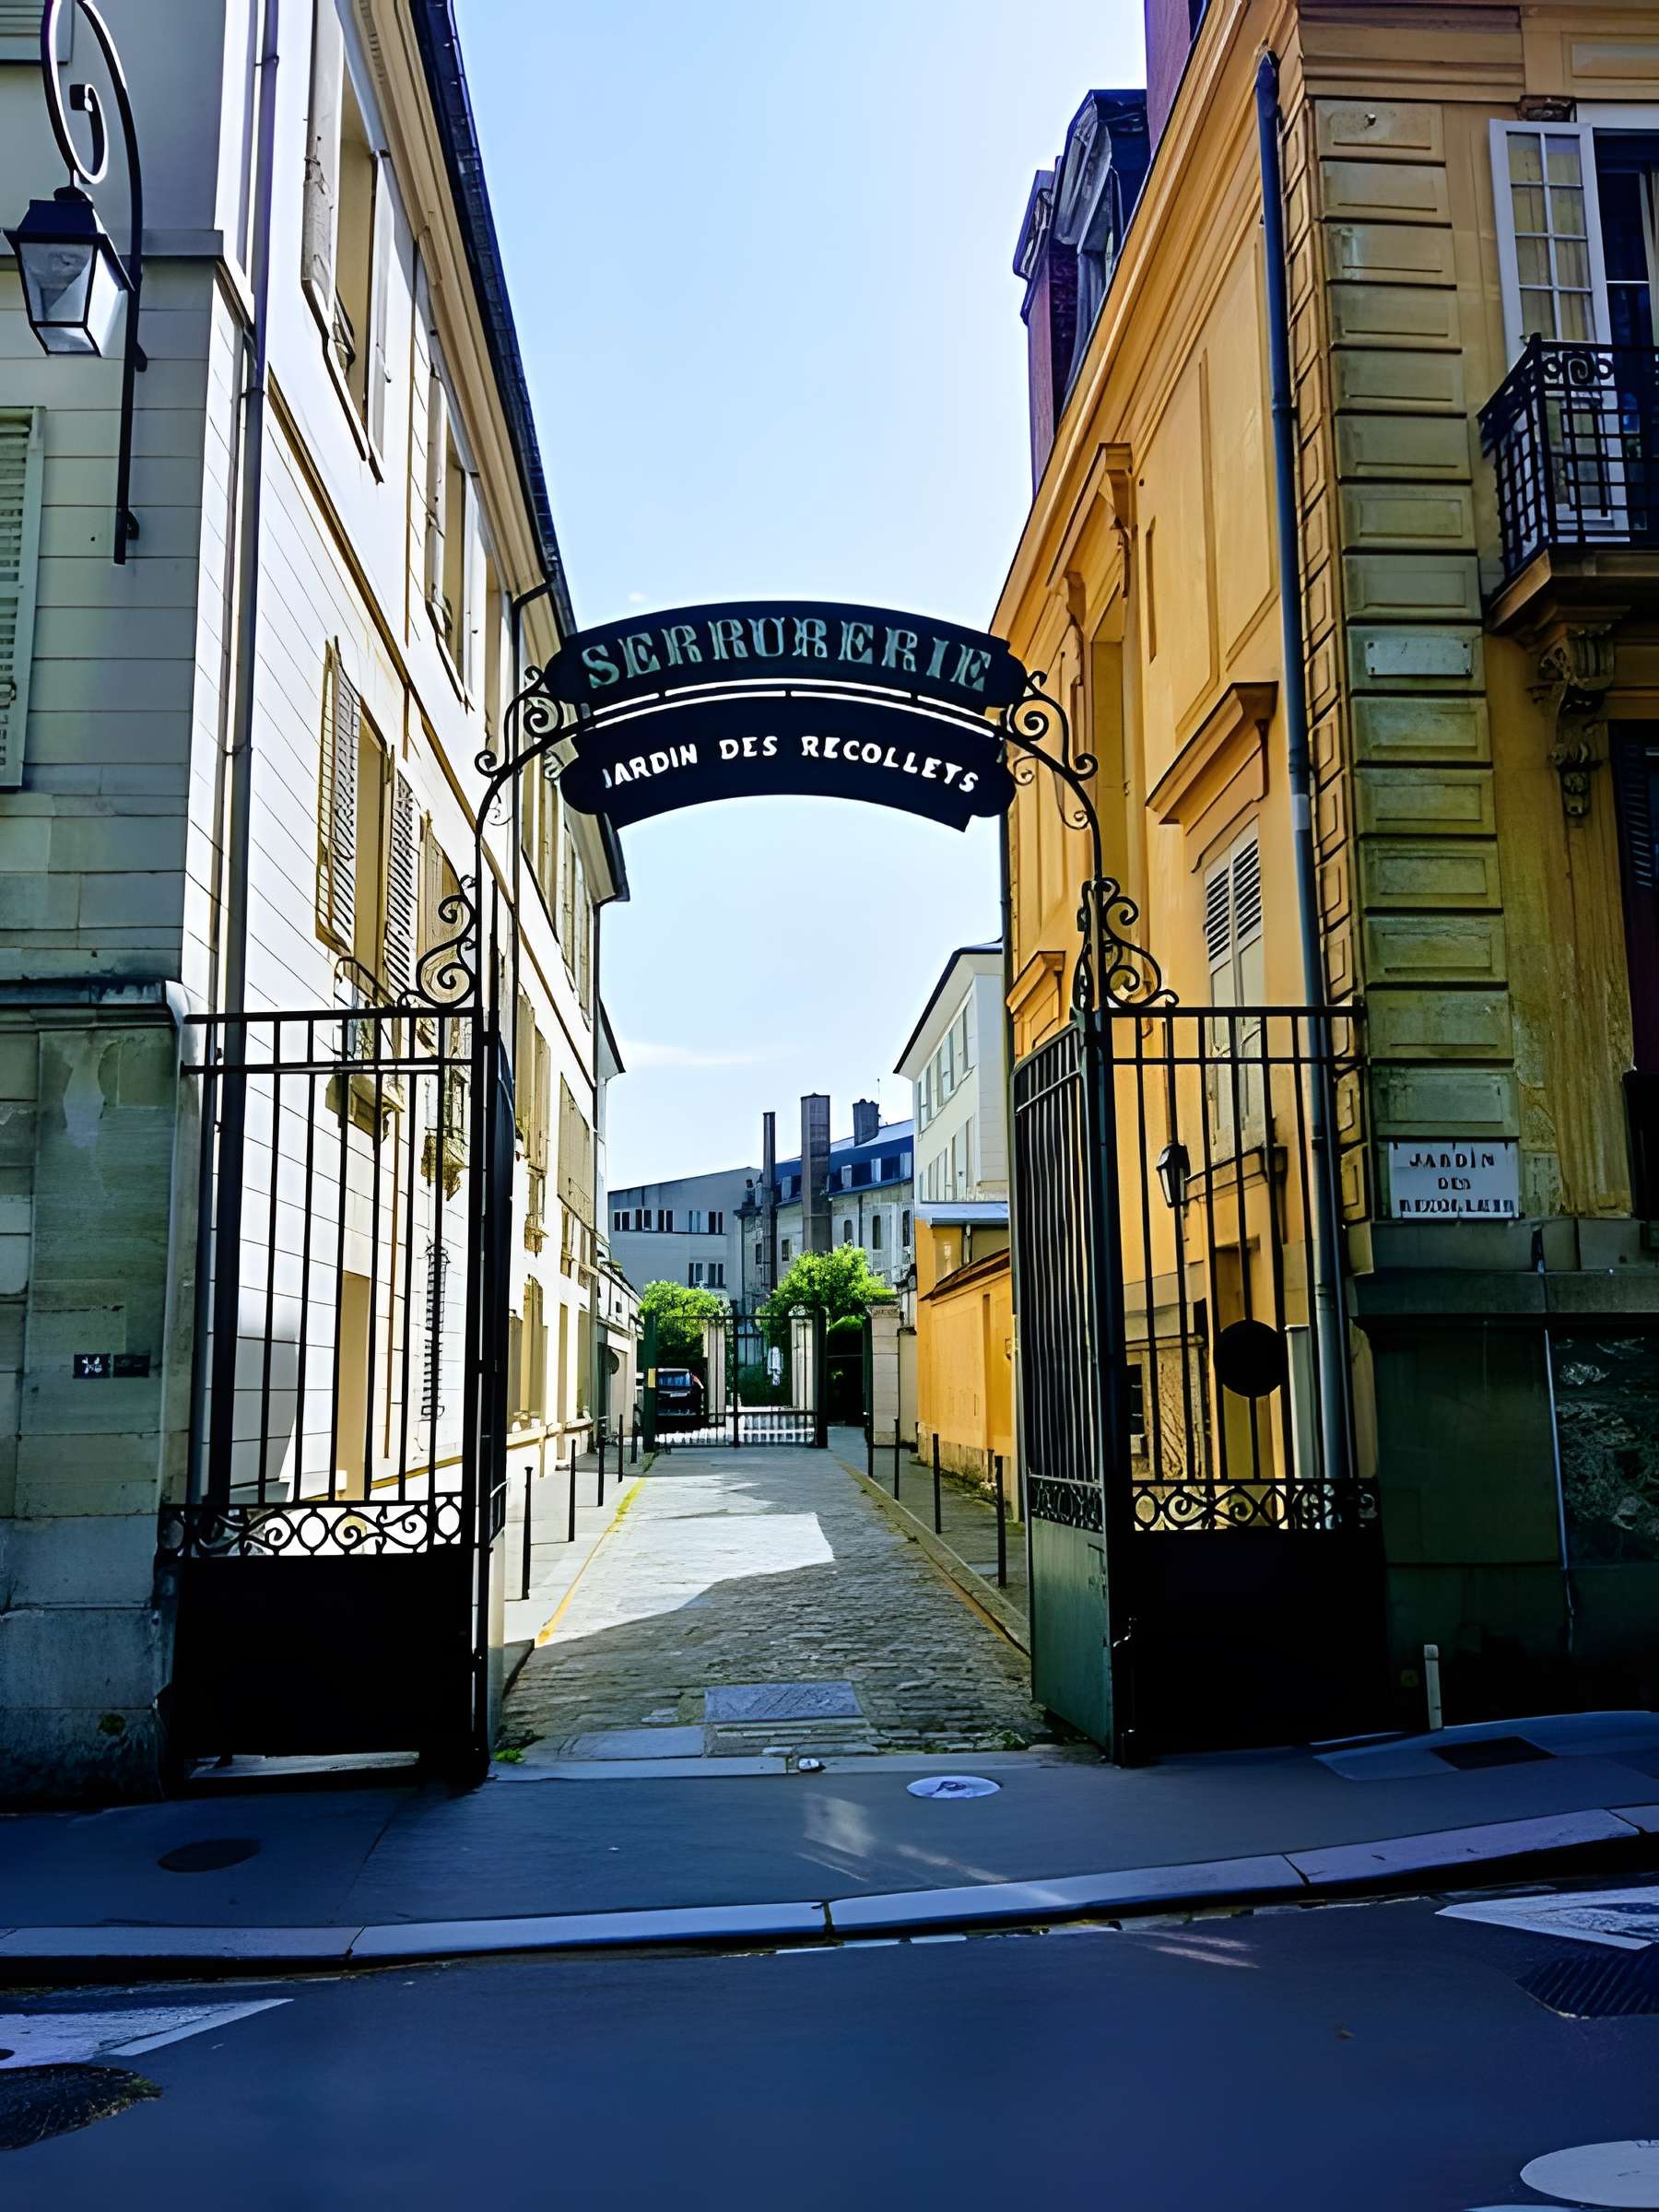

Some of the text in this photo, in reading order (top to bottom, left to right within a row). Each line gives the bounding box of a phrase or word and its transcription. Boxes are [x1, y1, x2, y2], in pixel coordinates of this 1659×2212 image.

[581, 617, 993, 691] SERRURERIE
[602, 735, 979, 793] JARDIN DES RECOLLETS
